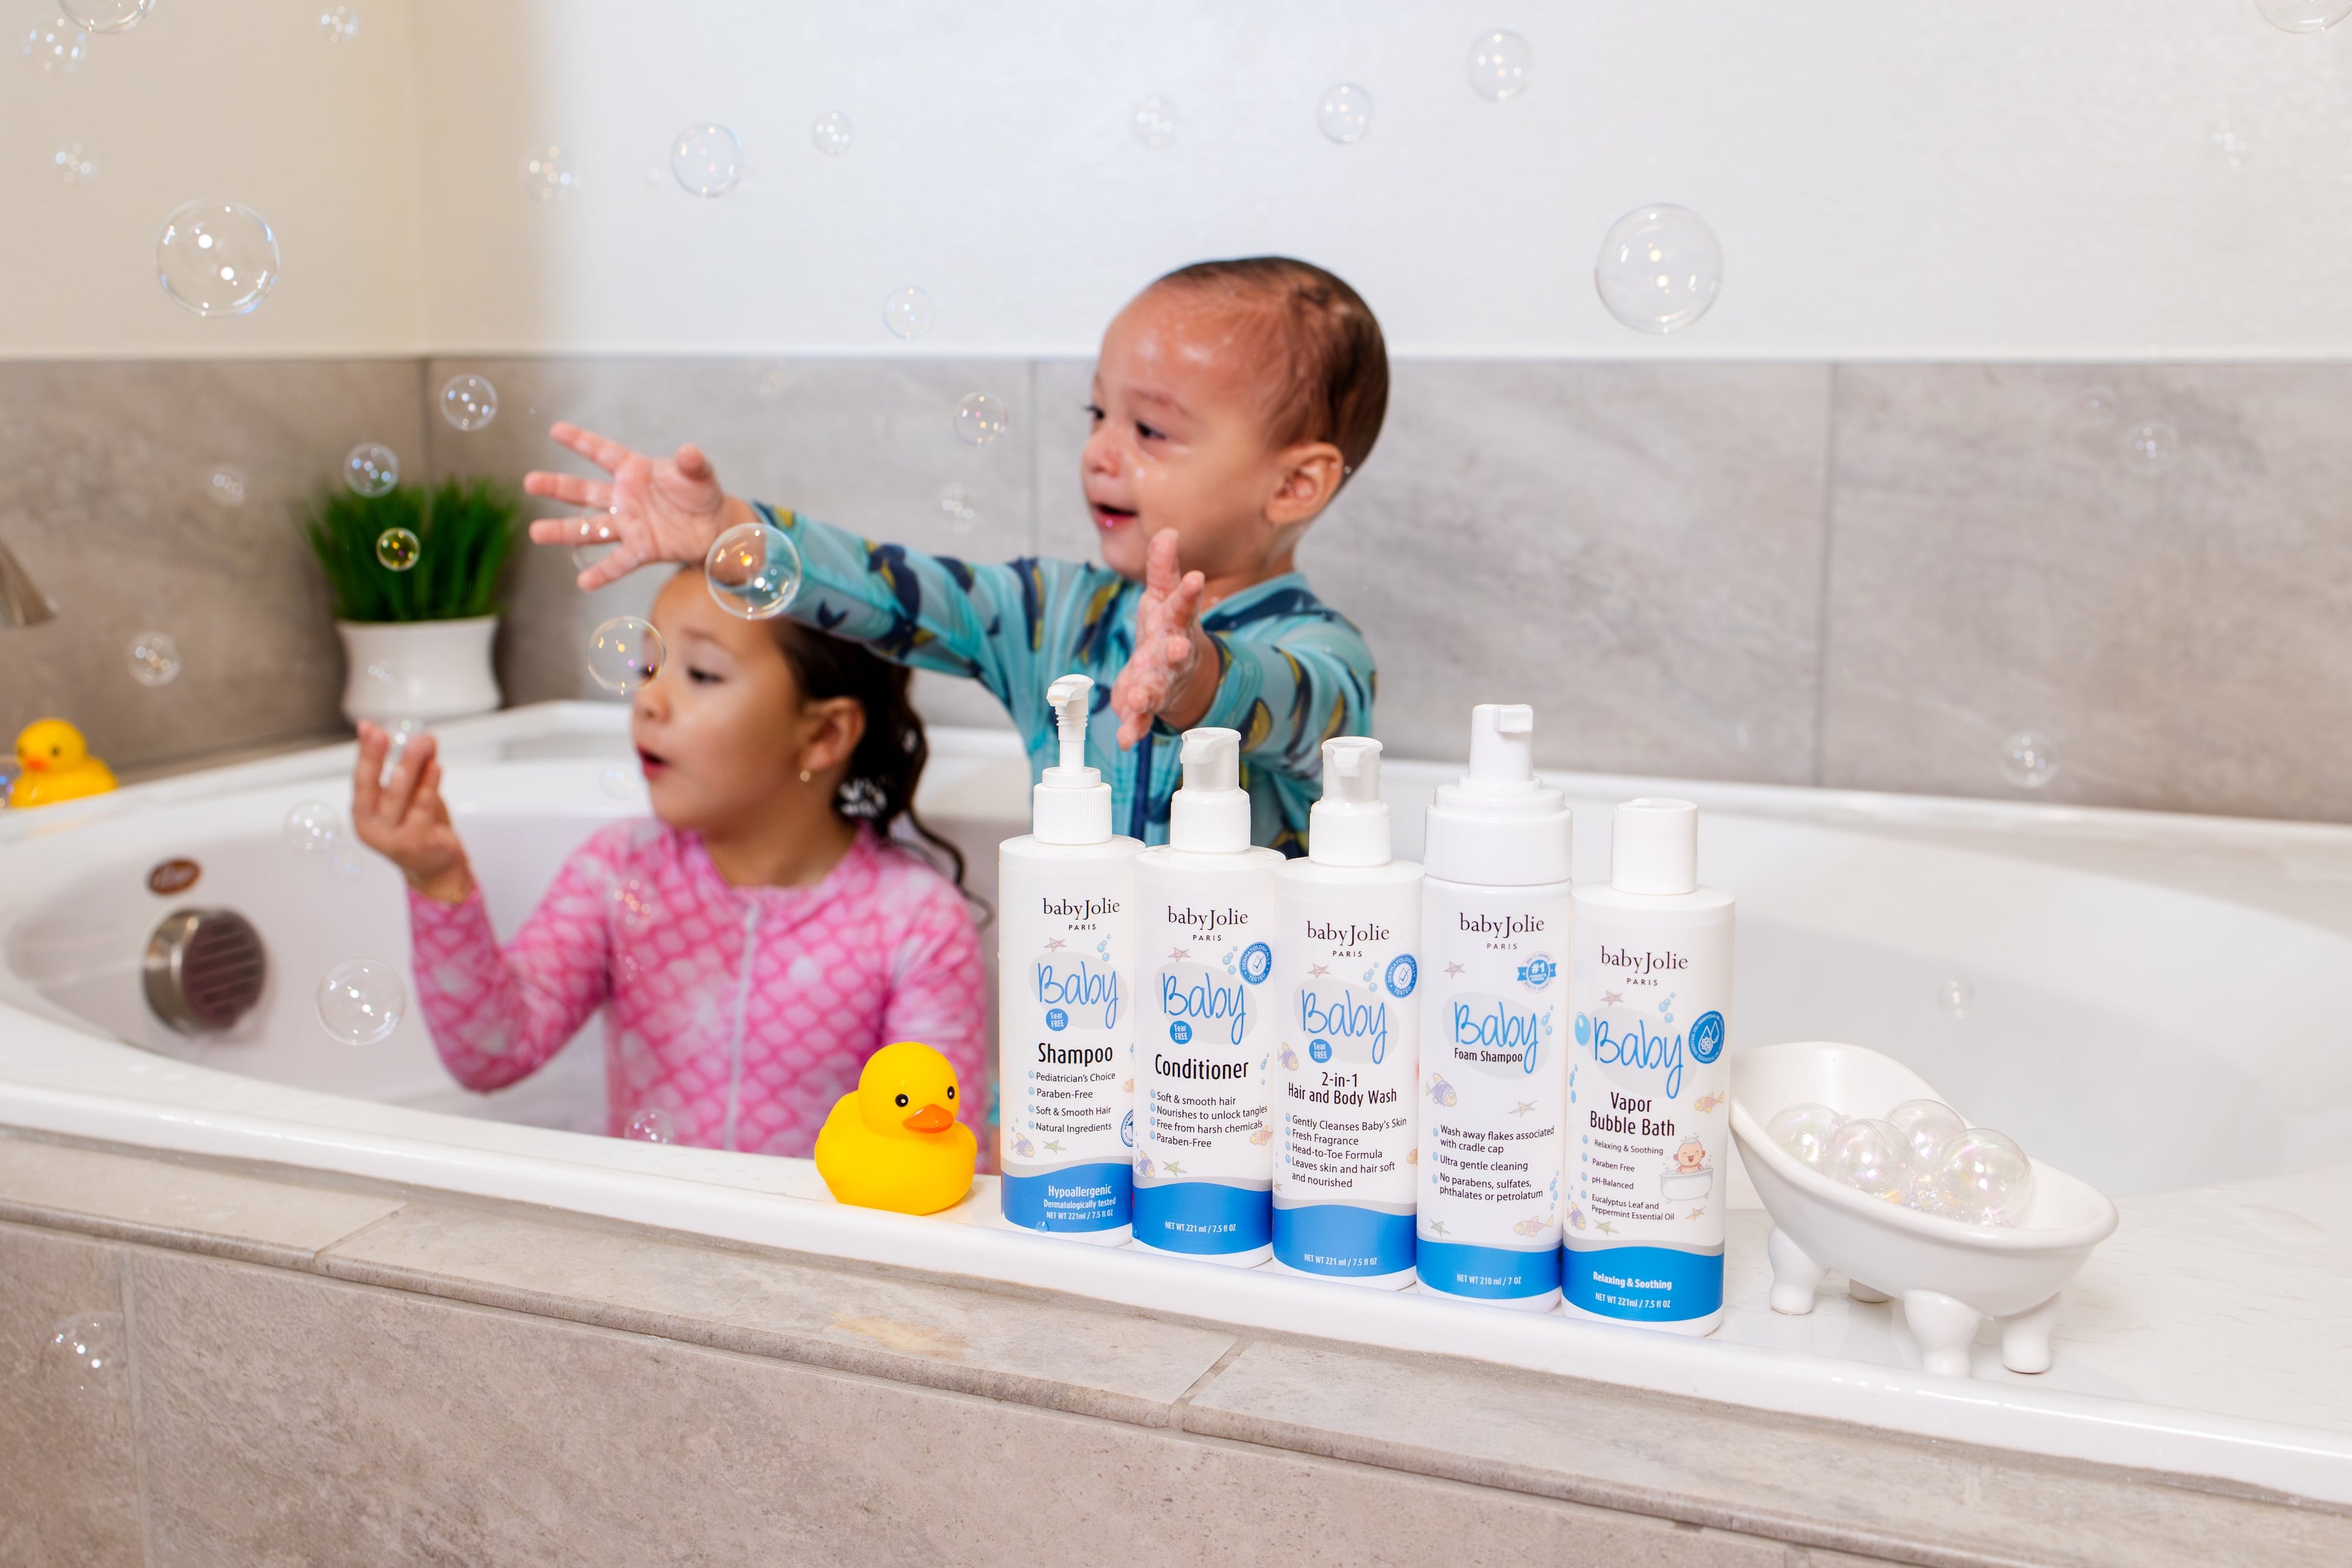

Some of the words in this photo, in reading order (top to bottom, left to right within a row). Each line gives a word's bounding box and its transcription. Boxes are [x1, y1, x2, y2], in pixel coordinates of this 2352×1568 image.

[1531, 963, 1545, 973] #1
[1038, 960, 1118, 1029] Baby
[1394, 986, 1411, 995] TESTED
[1163, 973, 1246, 1045] Baby
[1302, 989, 1387, 1065] Baby
[1454, 1001, 1539, 1074] Baby
[1038, 1042, 1113, 1067] Shampoo
[1454, 1047, 1477, 1061] Foam
[1480, 1051, 1523, 1064] Shampoo
[1594, 1017, 1683, 1099] Baby
[1155, 1054, 1249, 1079] Conditioner
[1036, 1072, 1088, 1082] Pediatrician's
[1090, 1072, 1115, 1082] Choice
[1322, 1072, 1357, 1087] 2-in-1
[1037, 1088, 1093, 1098] Paraben-Free
[1157, 1091, 1172, 1102] Soft
[1174, 1095, 1180, 1104] &
[1219, 1097, 1236, 1106] hair
[1288, 1082, 1305, 1100] Hair
[1310, 1090, 1329, 1103] and
[1334, 1090, 1363, 1107] Body
[1368, 1088, 1397, 1104] Wash
[1036, 1106, 1051, 1115] Soft
[1611, 1091, 1652, 1114] Vapor
[1157, 1106, 1197, 1119] Nourishes
[1200, 1111, 1209, 1120] to
[1212, 1110, 1240, 1119] unlock
[1243, 1106, 1268, 1118] tangles
[1036, 1123, 1065, 1132] Natural
[1067, 1123, 1112, 1134] Ingredients
[1157, 1120, 1172, 1130] Free
[1175, 1123, 1194, 1133] from
[1225, 1120, 1263, 1133] chemicals
[1292, 1115, 1317, 1129] Gently
[1319, 1120, 1359, 1131] Cleanses
[1362, 1121, 1390, 1132] Baby's
[1392, 1118, 1406, 1128] Skin
[1590, 1110, 1636, 1134] Bubble
[1642, 1118, 1675, 1136] Bath
[1157, 1133, 1212, 1147] Paraben-Free
[1292, 1129, 1311, 1142] Fresh
[1314, 1134, 1359, 1146] Fragrance
[1441, 1125, 1460, 1137] Wash
[1463, 1131, 1485, 1142] away
[1488, 1131, 1513, 1140] flakes
[1516, 1126, 1555, 1139] associated
[1292, 1143, 1343, 1159] Head-to-Toe
[1346, 1150, 1382, 1159] Formula
[1441, 1139, 1457, 1148] with
[1459, 1143, 1485, 1152] cradle
[1488, 1145, 1504, 1155] cap
[1594, 1140, 1621, 1152] Relaxing
[1630, 1145, 1664, 1156] Soothing
[1292, 1157, 1317, 1171] Leaves
[1320, 1164, 1337, 1173] skin
[1340, 1164, 1357, 1174] and
[1360, 1164, 1377, 1173] hair
[1380, 1162, 1395, 1172] soft
[1440, 1155, 1457, 1166] Ultra
[1460, 1160, 1488, 1170] gentle
[1491, 1162, 1528, 1172] cleaning
[1593, 1158, 1618, 1170] Paraben
[1620, 1164, 1635, 1172] Free
[1292, 1173, 1305, 1182] and
[1308, 1177, 1352, 1188] nourished
[1440, 1172, 1450, 1182] No
[1452, 1176, 1494, 1189] parabens,
[1496, 1179, 1531, 1188] sulfates,
[1592, 1177, 1634, 1189] pH-Balanced
[1048, 1184, 1112, 1199] Hypoallergenic
[1440, 1186, 1482, 1200] phthalates
[1497, 1190, 1543, 1202] petrolatum
[1044, 1199, 1096, 1210] Dermatologically
[1098, 1197, 1116, 1207] tested
[1592, 1194, 1627, 1207] Eucalyptus
[1629, 1200, 1643, 1209] Leaf
[1592, 1205, 1630, 1218] Peppermint
[1632, 1212, 1663, 1220] Essential
[1304, 1254, 1314, 1262] NET
[1348, 1258, 1351, 1267] /
[1457, 1274, 1468, 1283] NET
[1593, 1272, 1625, 1287] Relaxing
[1627, 1278, 1633, 1287] &
[1635, 1278, 1672, 1291] Soothing
[1596, 1292, 1605, 1302] NET
[1607, 1295, 1616, 1304] WT
[1618, 1297, 1637, 1307] 221ml
[1639, 1300, 1643, 1308] /
[1645, 1300, 1655, 1308] 7.5
